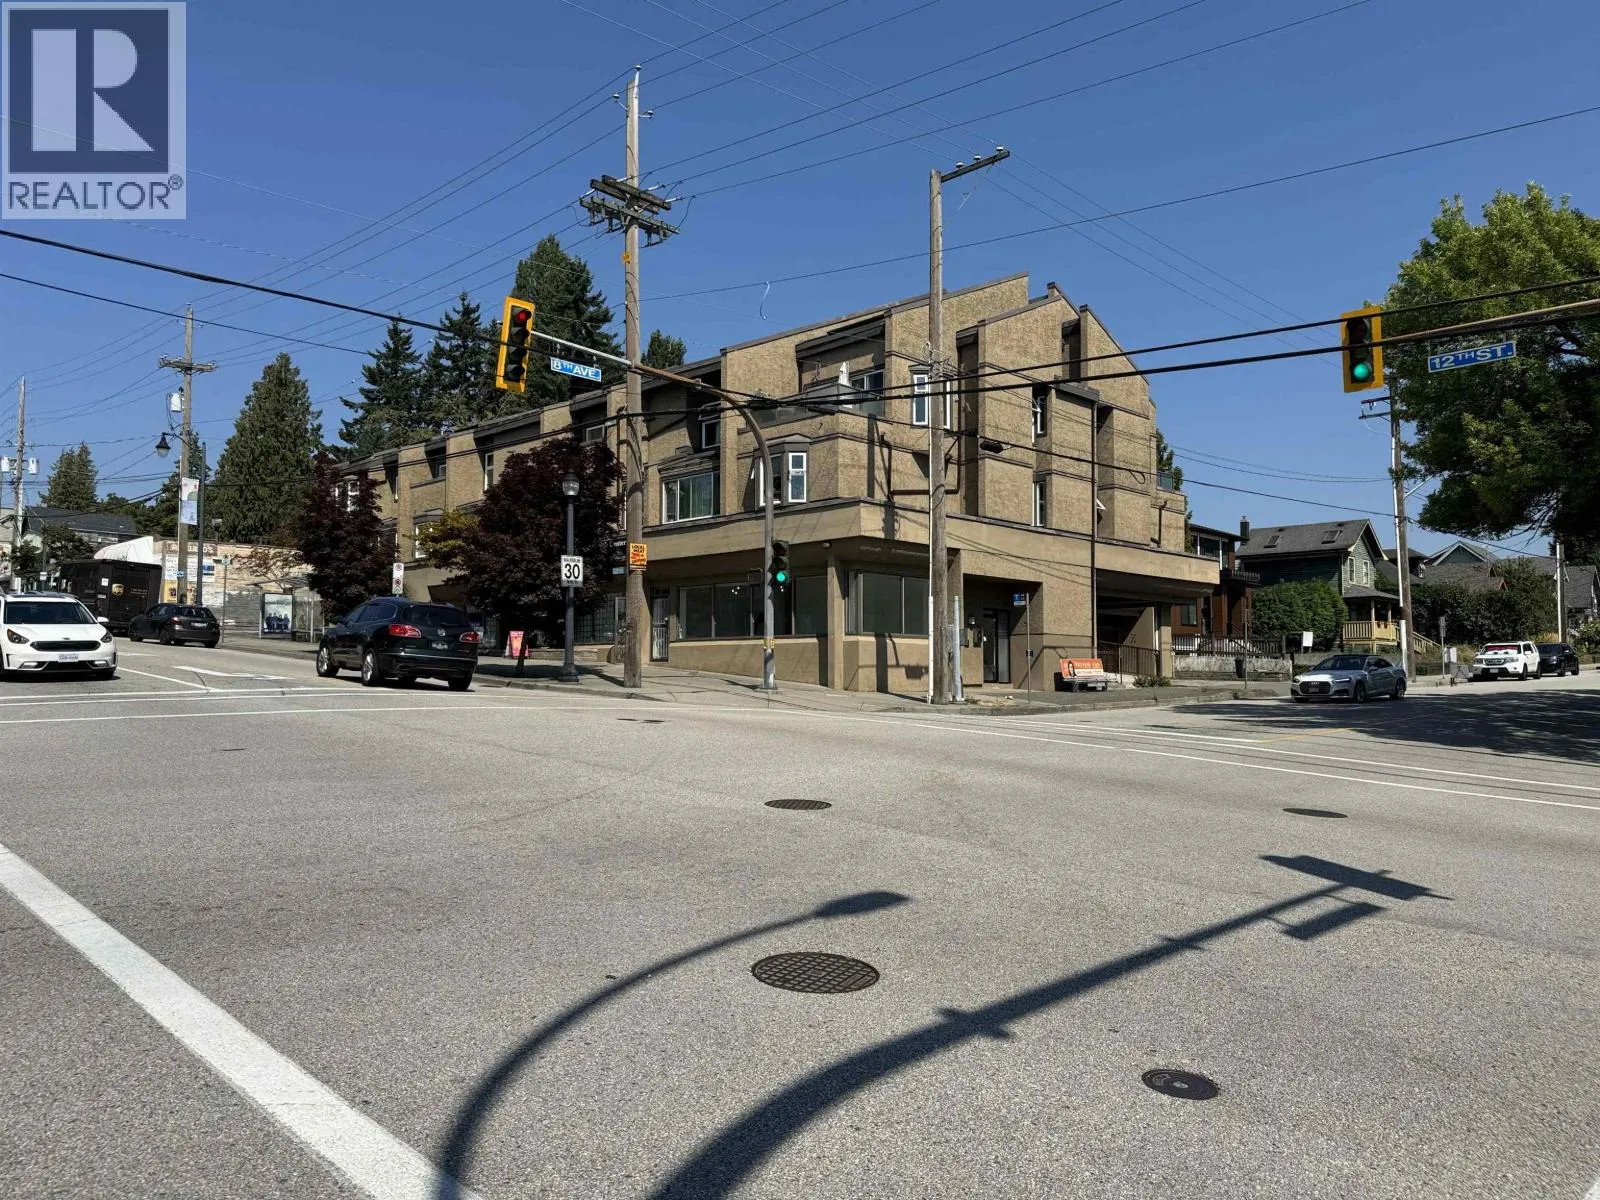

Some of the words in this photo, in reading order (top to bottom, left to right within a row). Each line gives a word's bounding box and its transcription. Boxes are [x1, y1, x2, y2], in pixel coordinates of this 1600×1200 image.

[1431, 350, 1475, 369] 12TH
[1476, 345, 1513, 361] ST.
[553, 360, 573, 370] 8TH
[573, 366, 600, 379] AVE.
[565, 564, 580, 579] 30
